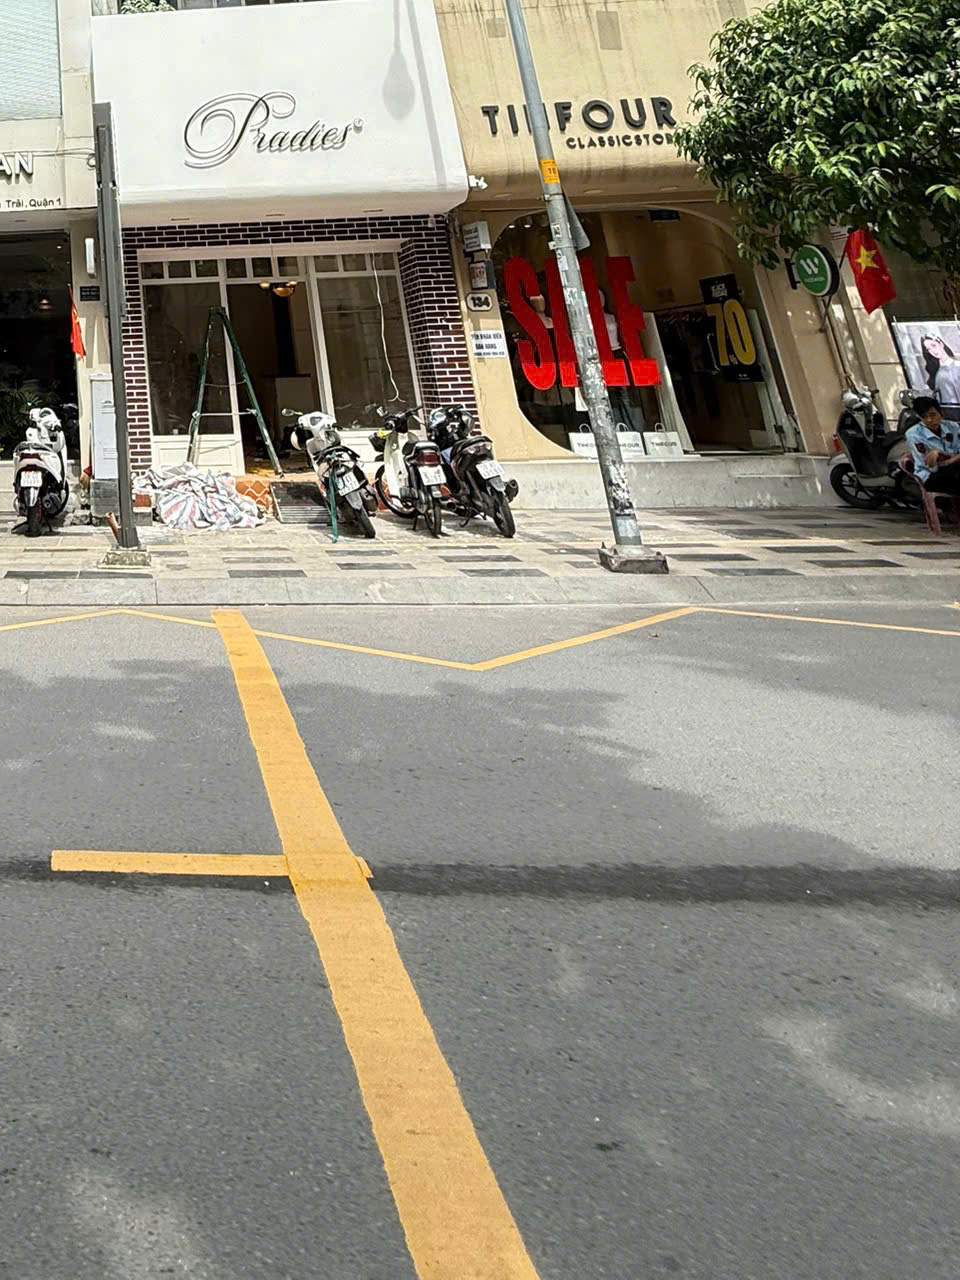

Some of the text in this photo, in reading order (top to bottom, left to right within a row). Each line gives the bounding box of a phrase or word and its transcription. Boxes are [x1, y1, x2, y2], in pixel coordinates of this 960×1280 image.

[566, 133, 674, 150] CLASSICSTOR
[56, 197, 62, 206] 1
[705, 299, 757, 366] 70
